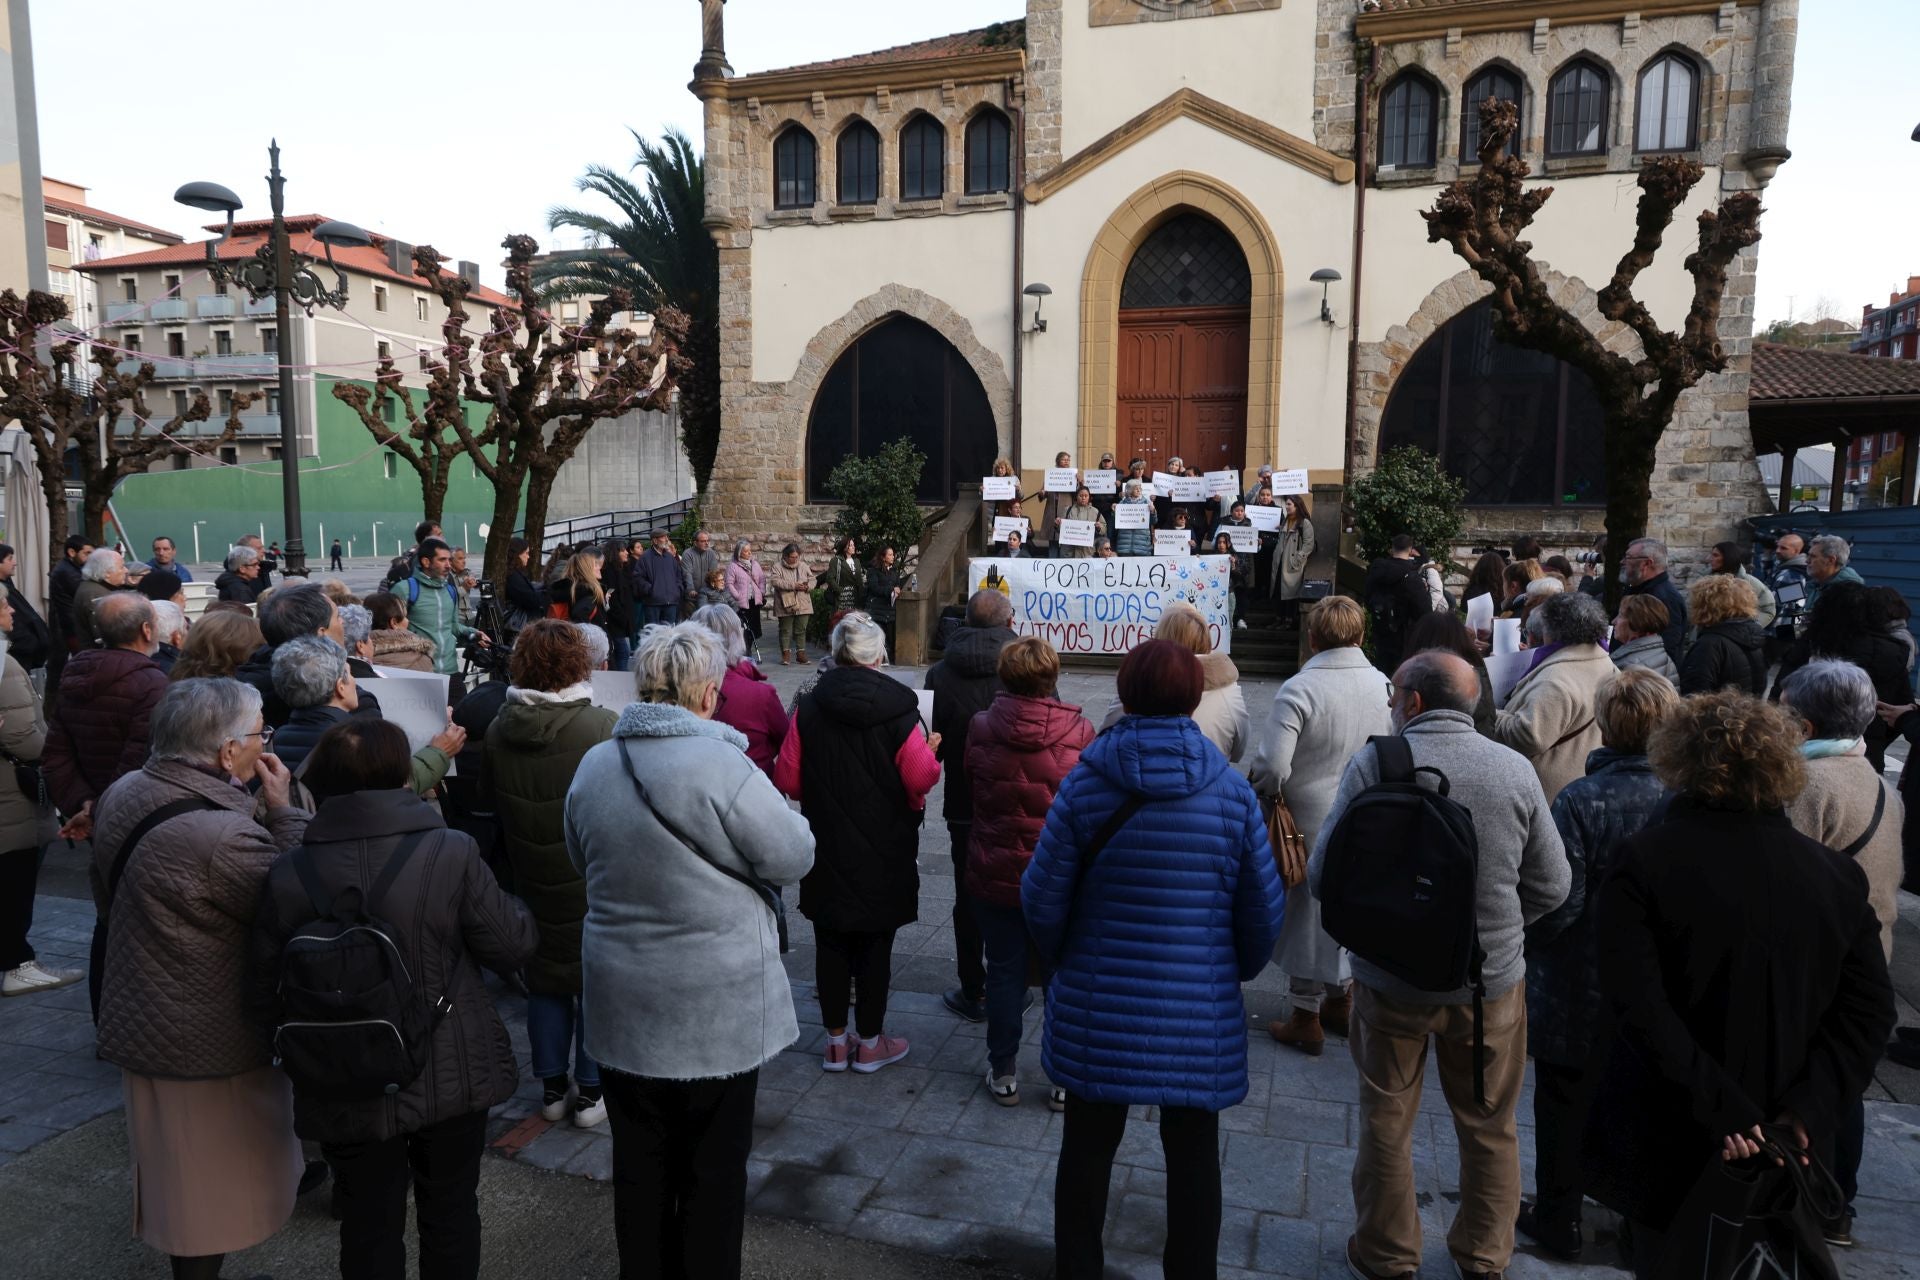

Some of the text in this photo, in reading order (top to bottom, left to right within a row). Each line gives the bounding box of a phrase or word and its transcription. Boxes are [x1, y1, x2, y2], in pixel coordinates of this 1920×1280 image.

[1104, 562, 1171, 592] ELLA,
[1024, 591, 1162, 623] POR TODAS
